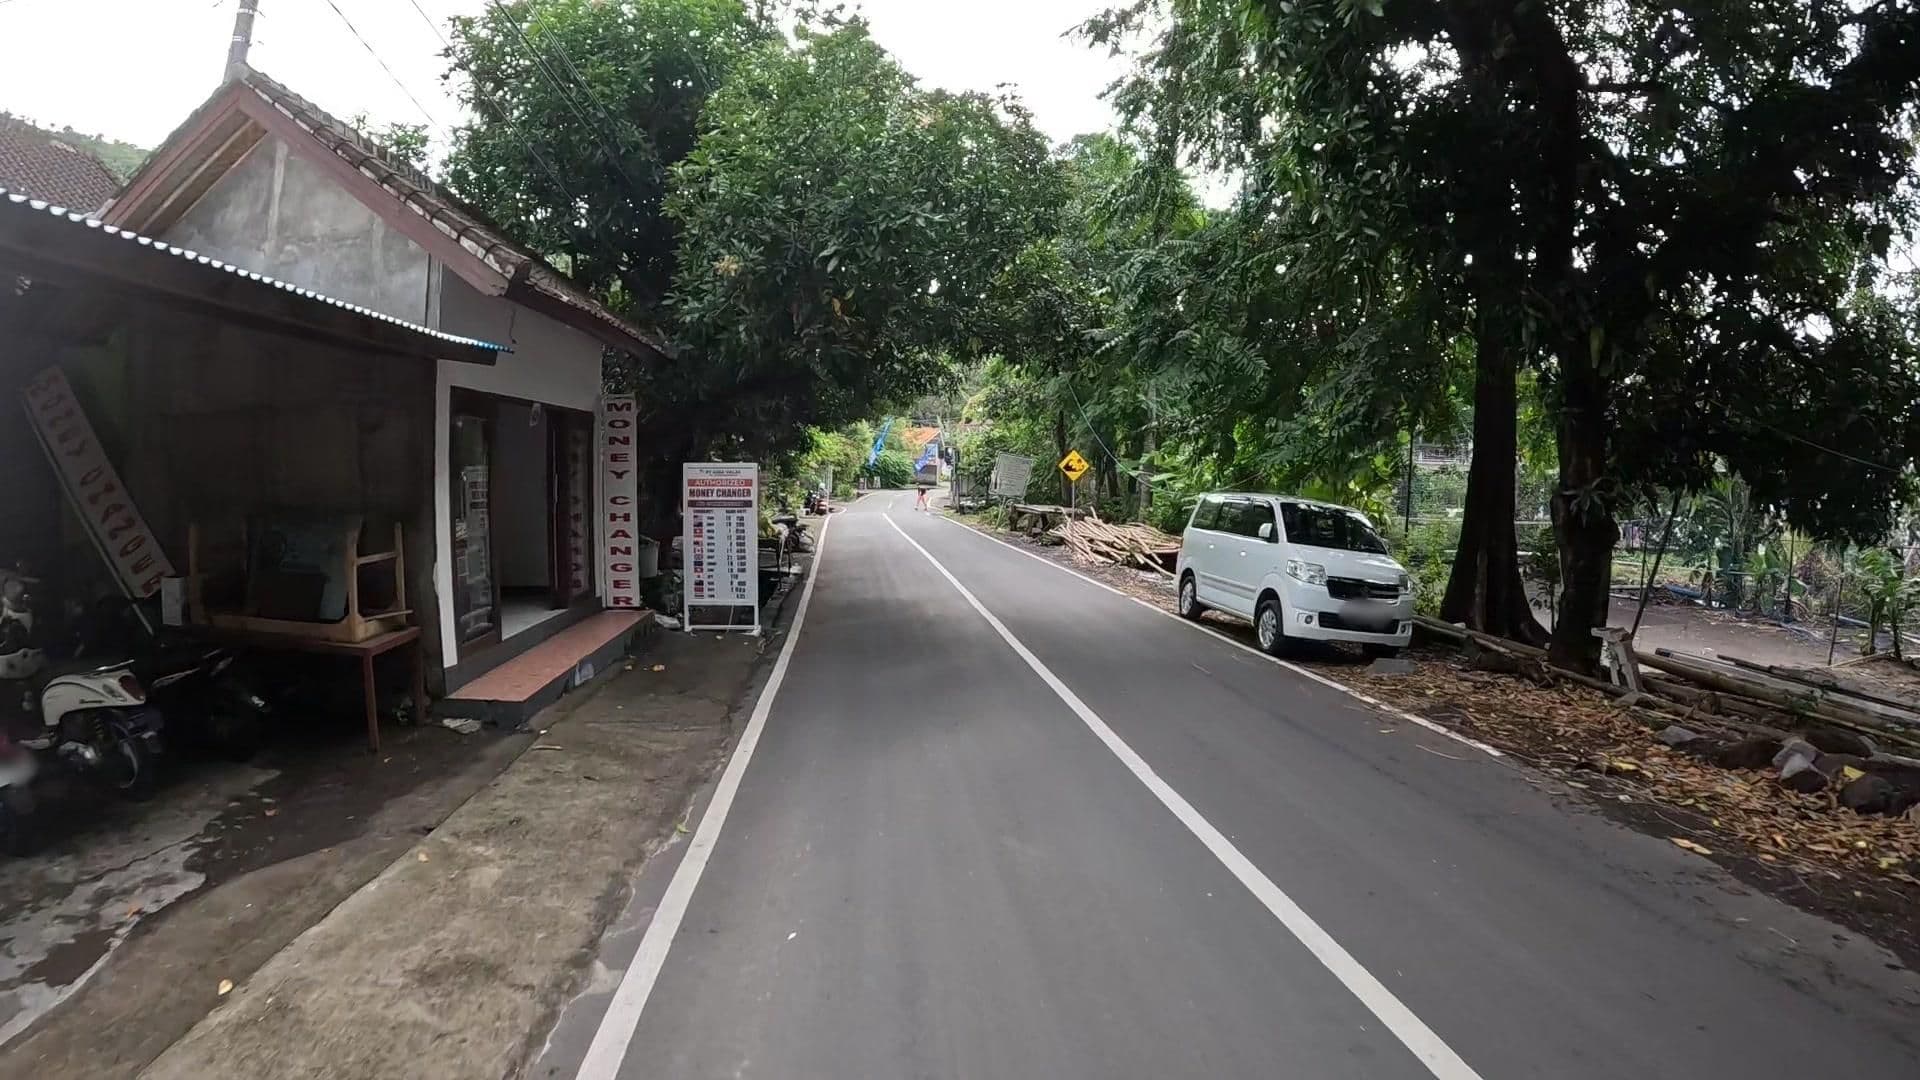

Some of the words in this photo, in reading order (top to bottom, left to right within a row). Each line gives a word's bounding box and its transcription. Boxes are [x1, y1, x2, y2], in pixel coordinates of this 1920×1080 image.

[606, 402, 632, 479] MONEY
[688, 487, 715, 497] MONEY
[716, 487, 752, 497] CHANGER
[609, 495, 633, 605] CHANGER
